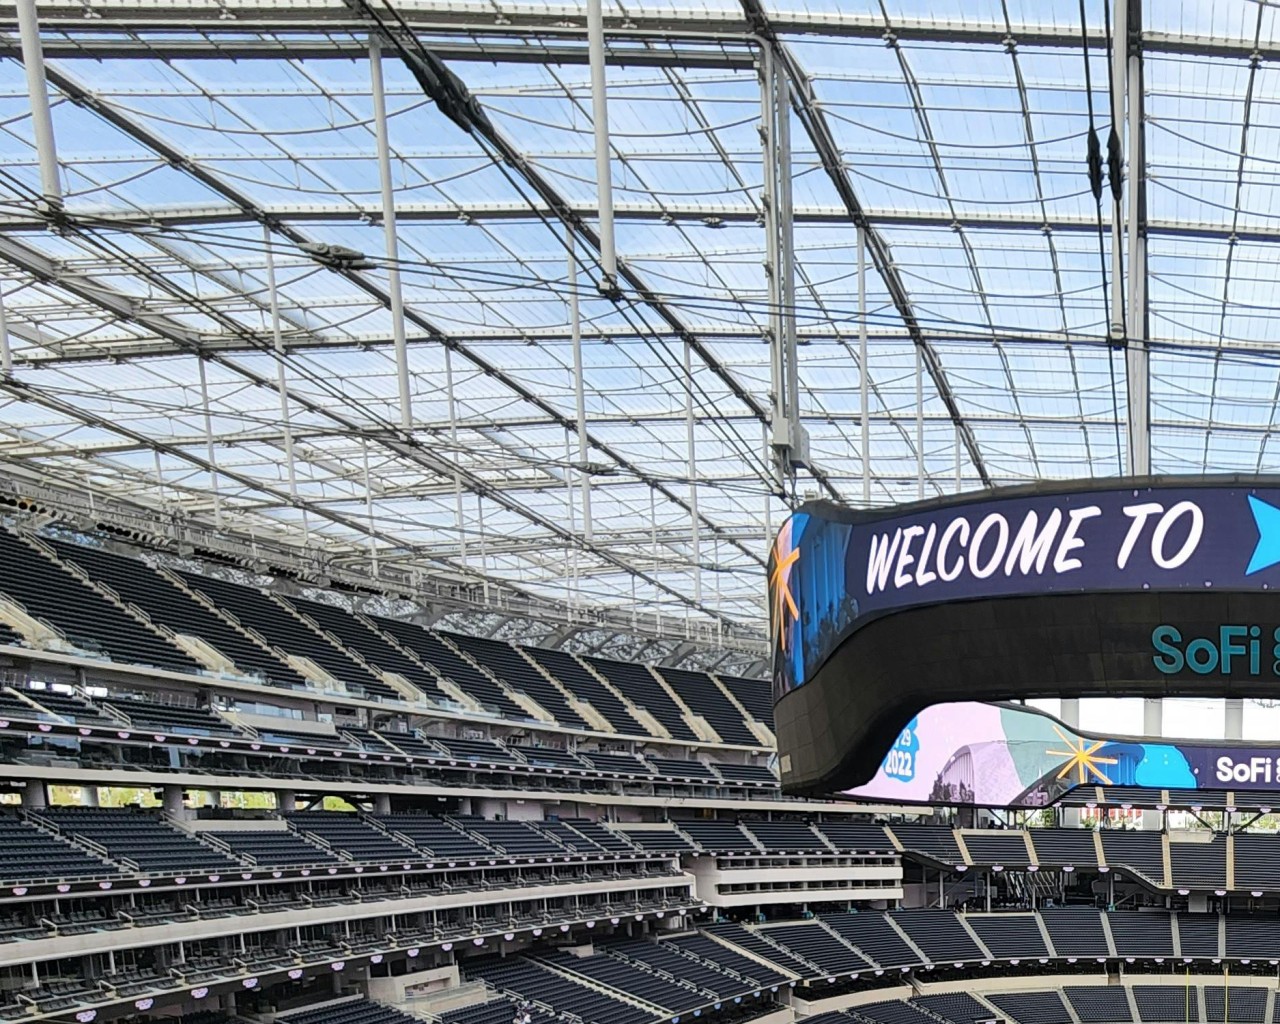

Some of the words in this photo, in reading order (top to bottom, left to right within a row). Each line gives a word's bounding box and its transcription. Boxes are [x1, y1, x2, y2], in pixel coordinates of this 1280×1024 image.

[866, 505, 1101, 594] WELCOME
[1117, 500, 1204, 570] TO
[1151, 625, 1261, 676] SoFi
[885, 750, 912, 777] 2022
[1216, 756, 1272, 783] SoFi
